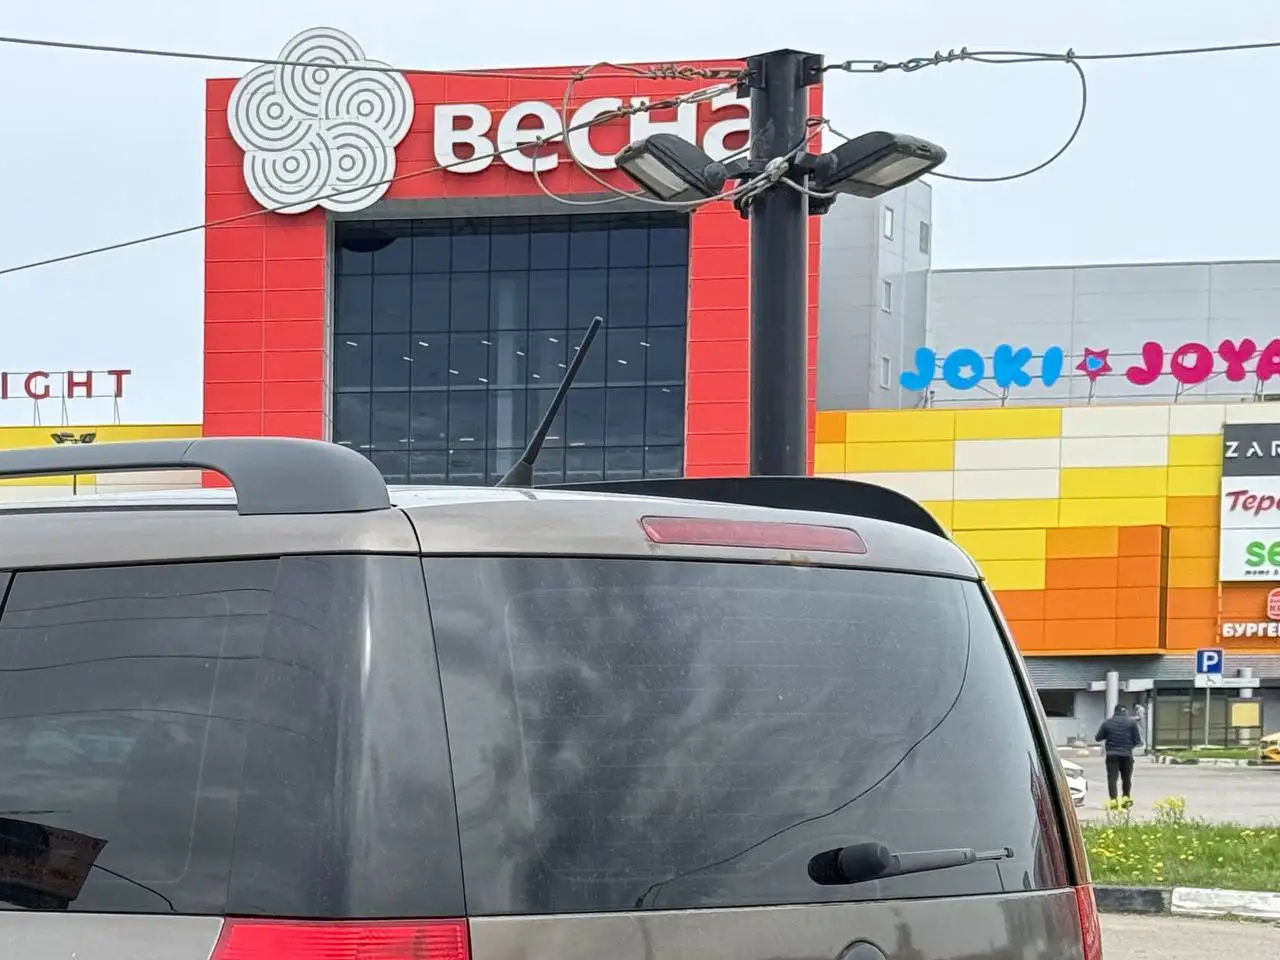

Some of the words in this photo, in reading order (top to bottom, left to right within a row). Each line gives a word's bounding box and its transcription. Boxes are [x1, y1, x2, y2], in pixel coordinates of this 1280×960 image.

[900, 344, 1064, 392] JOKI
[1223, 622, 1280, 637] БУРГЕ
[1203, 652, 1218, 672] P
